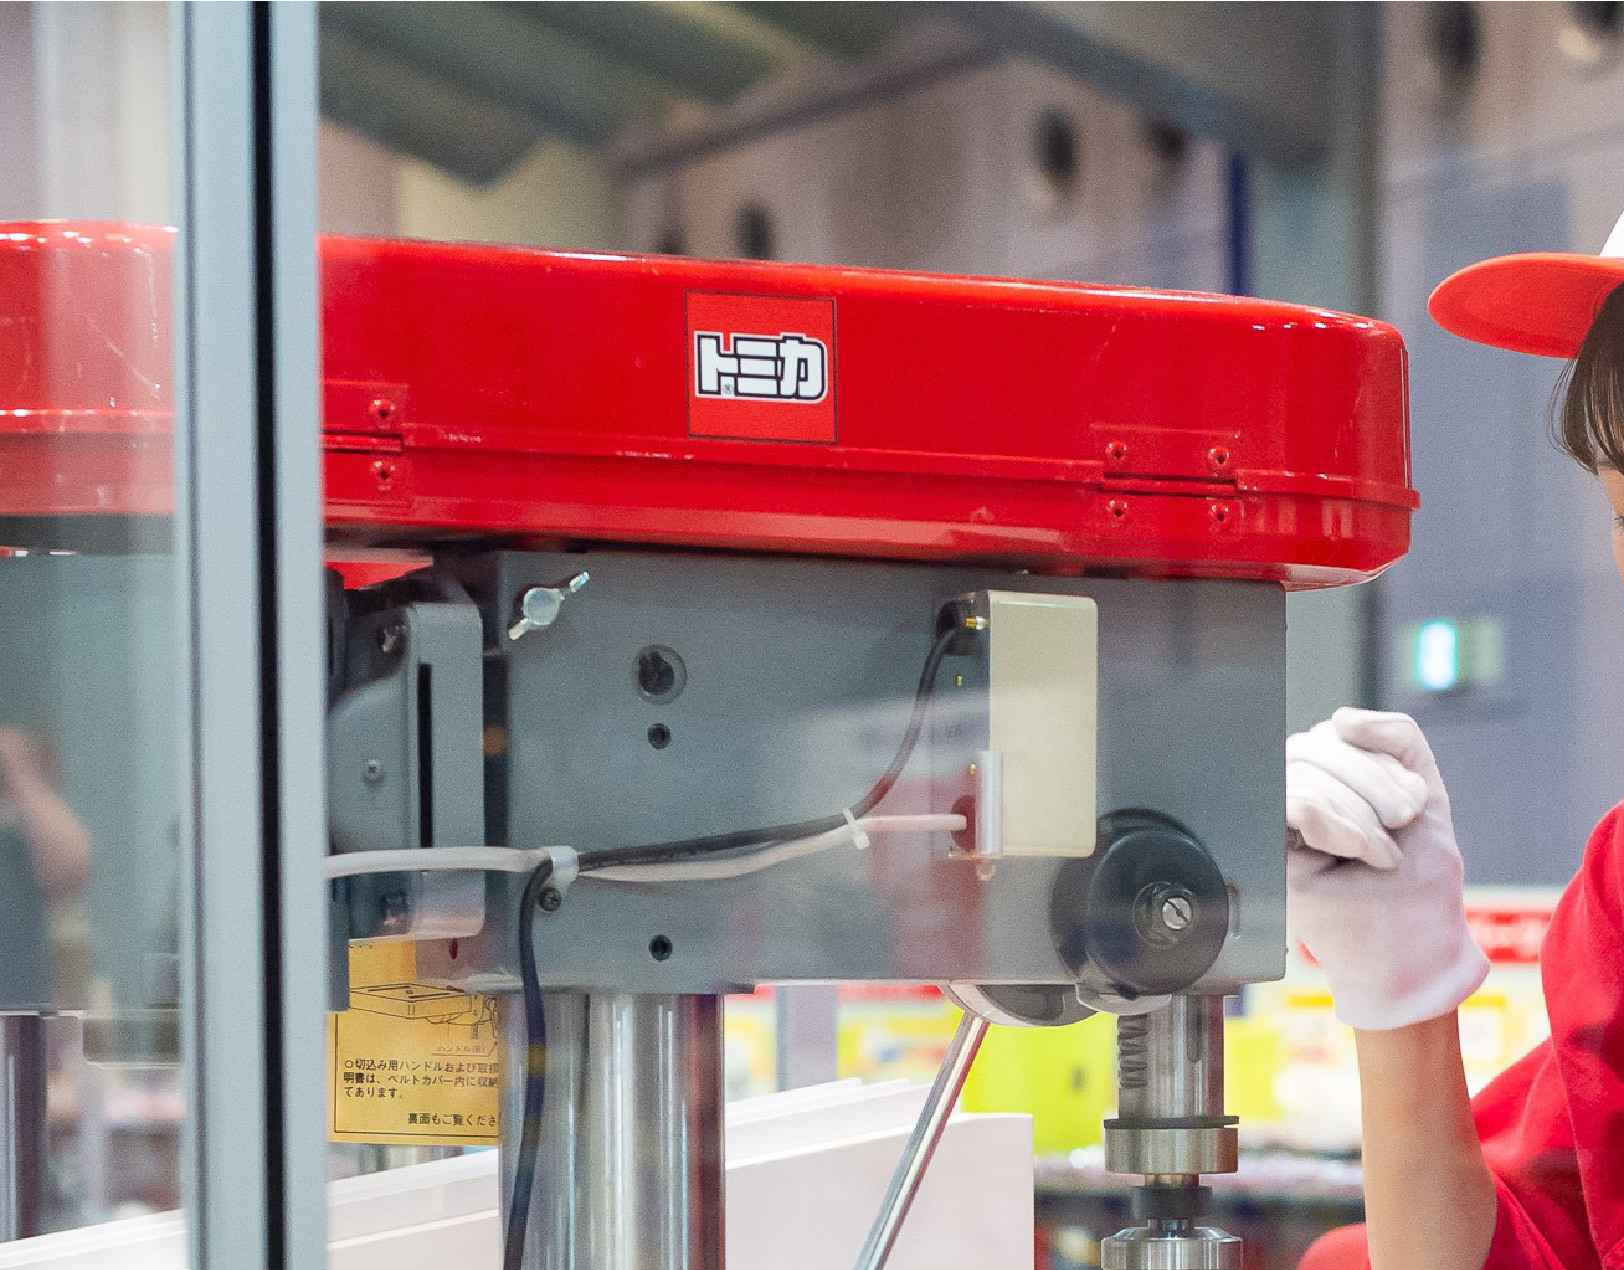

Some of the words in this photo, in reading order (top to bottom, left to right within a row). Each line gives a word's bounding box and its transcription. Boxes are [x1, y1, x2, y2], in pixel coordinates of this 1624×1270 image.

[695, 332, 828, 403] トミカ
[344, 1086, 402, 1099] てあります。
[407, 1112, 497, 1127] 裏面もご覧くださ
